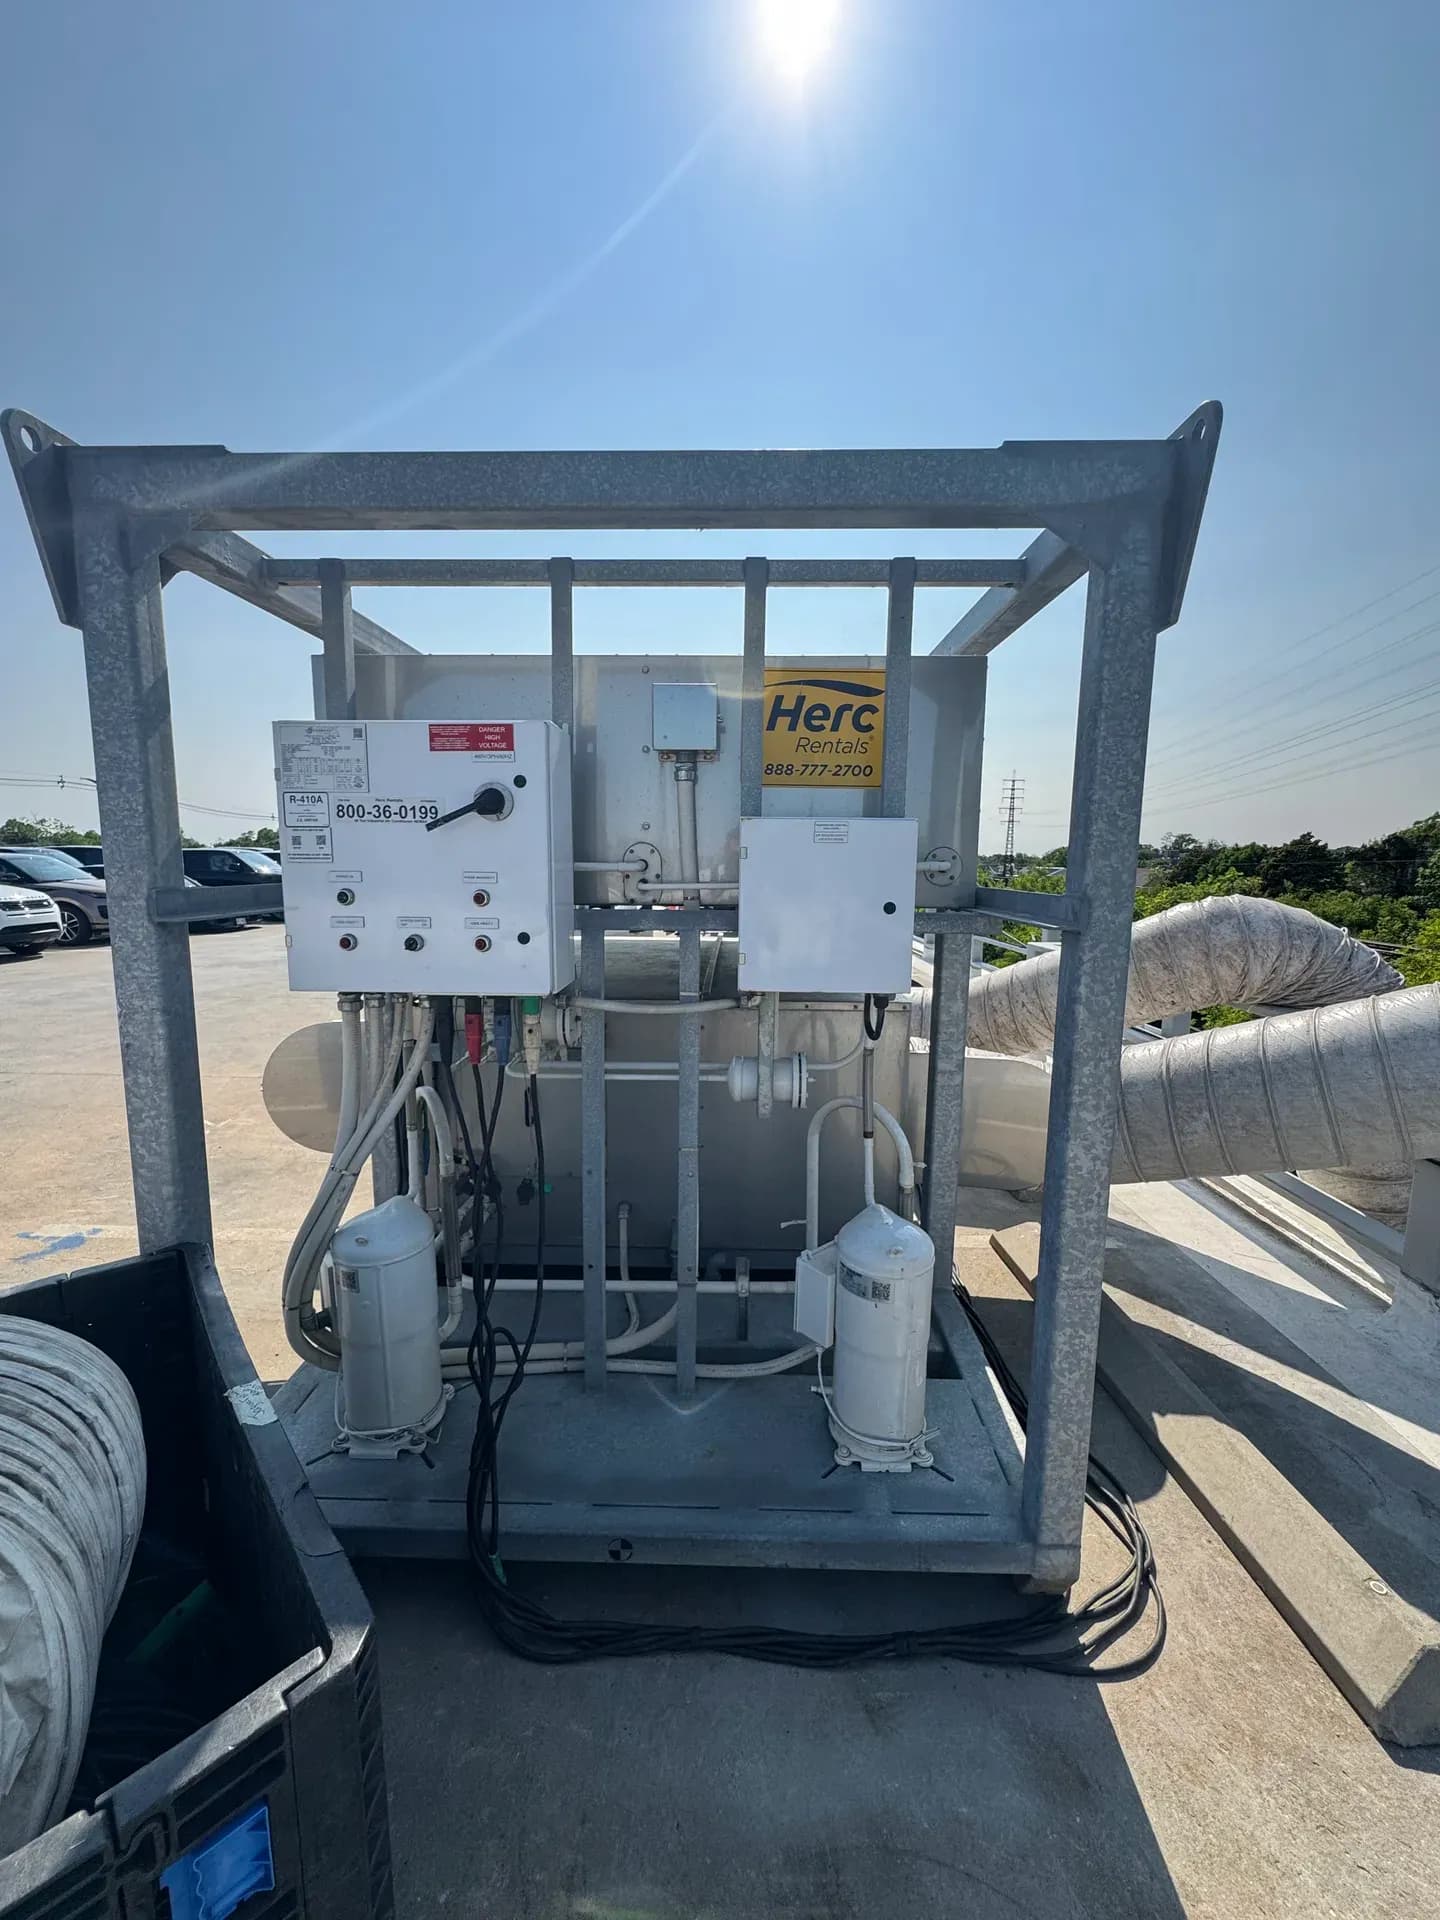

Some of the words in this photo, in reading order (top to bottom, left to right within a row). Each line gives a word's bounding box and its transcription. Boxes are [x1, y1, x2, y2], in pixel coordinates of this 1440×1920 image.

[765, 694, 880, 733] Herc
[795, 737, 869, 754] Rentals
[764, 763, 873, 777] 888-777-2700
[289, 795, 324, 804] R-410A
[336, 804, 439, 820] 800-36-0199
